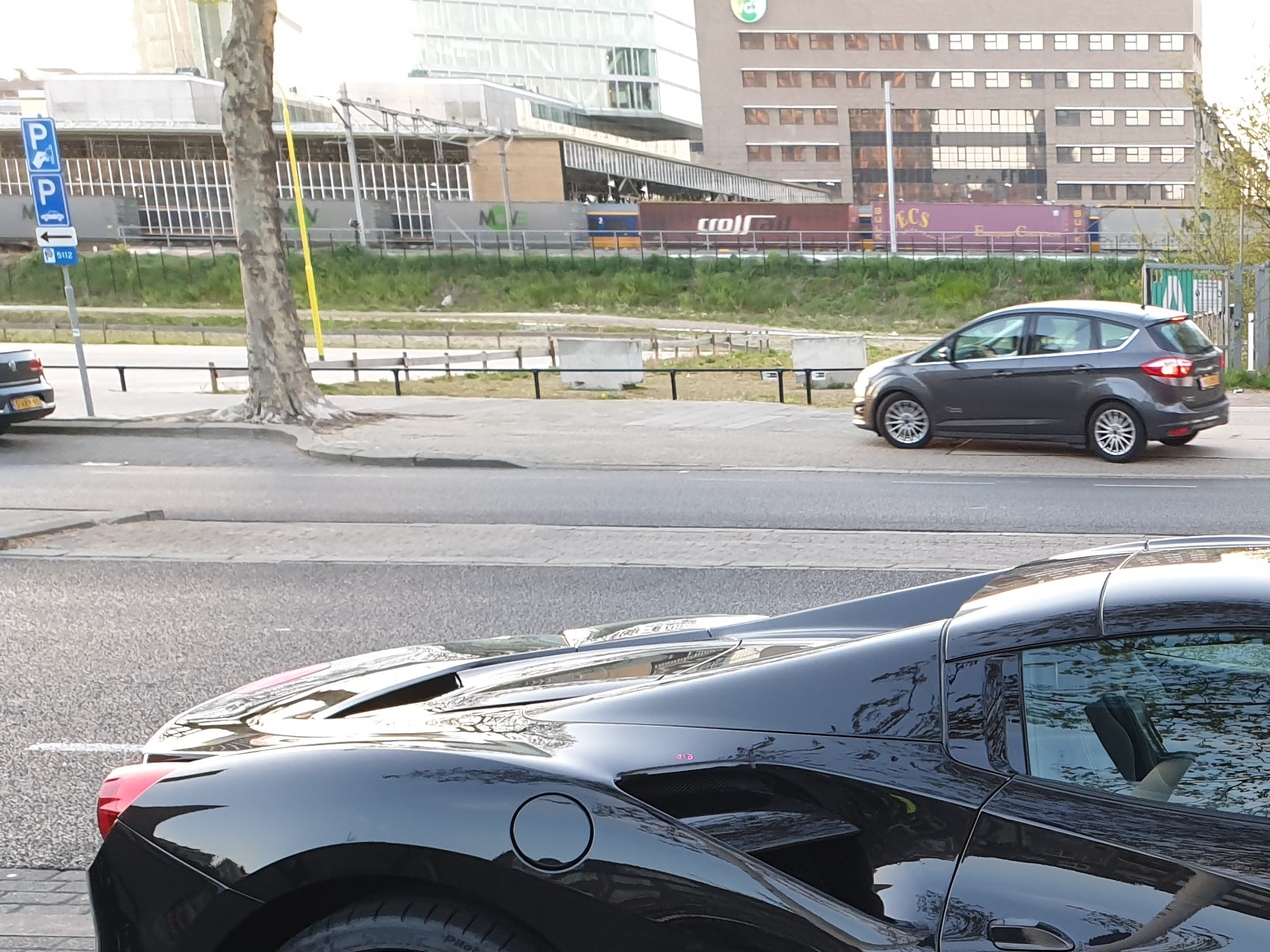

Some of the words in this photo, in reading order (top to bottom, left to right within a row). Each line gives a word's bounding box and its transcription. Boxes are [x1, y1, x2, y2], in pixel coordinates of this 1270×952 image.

[28, 122, 48, 151] P
[38, 178, 56, 206] P
[896, 207, 930, 229] ECS
[56, 251, 73, 260] 5112
